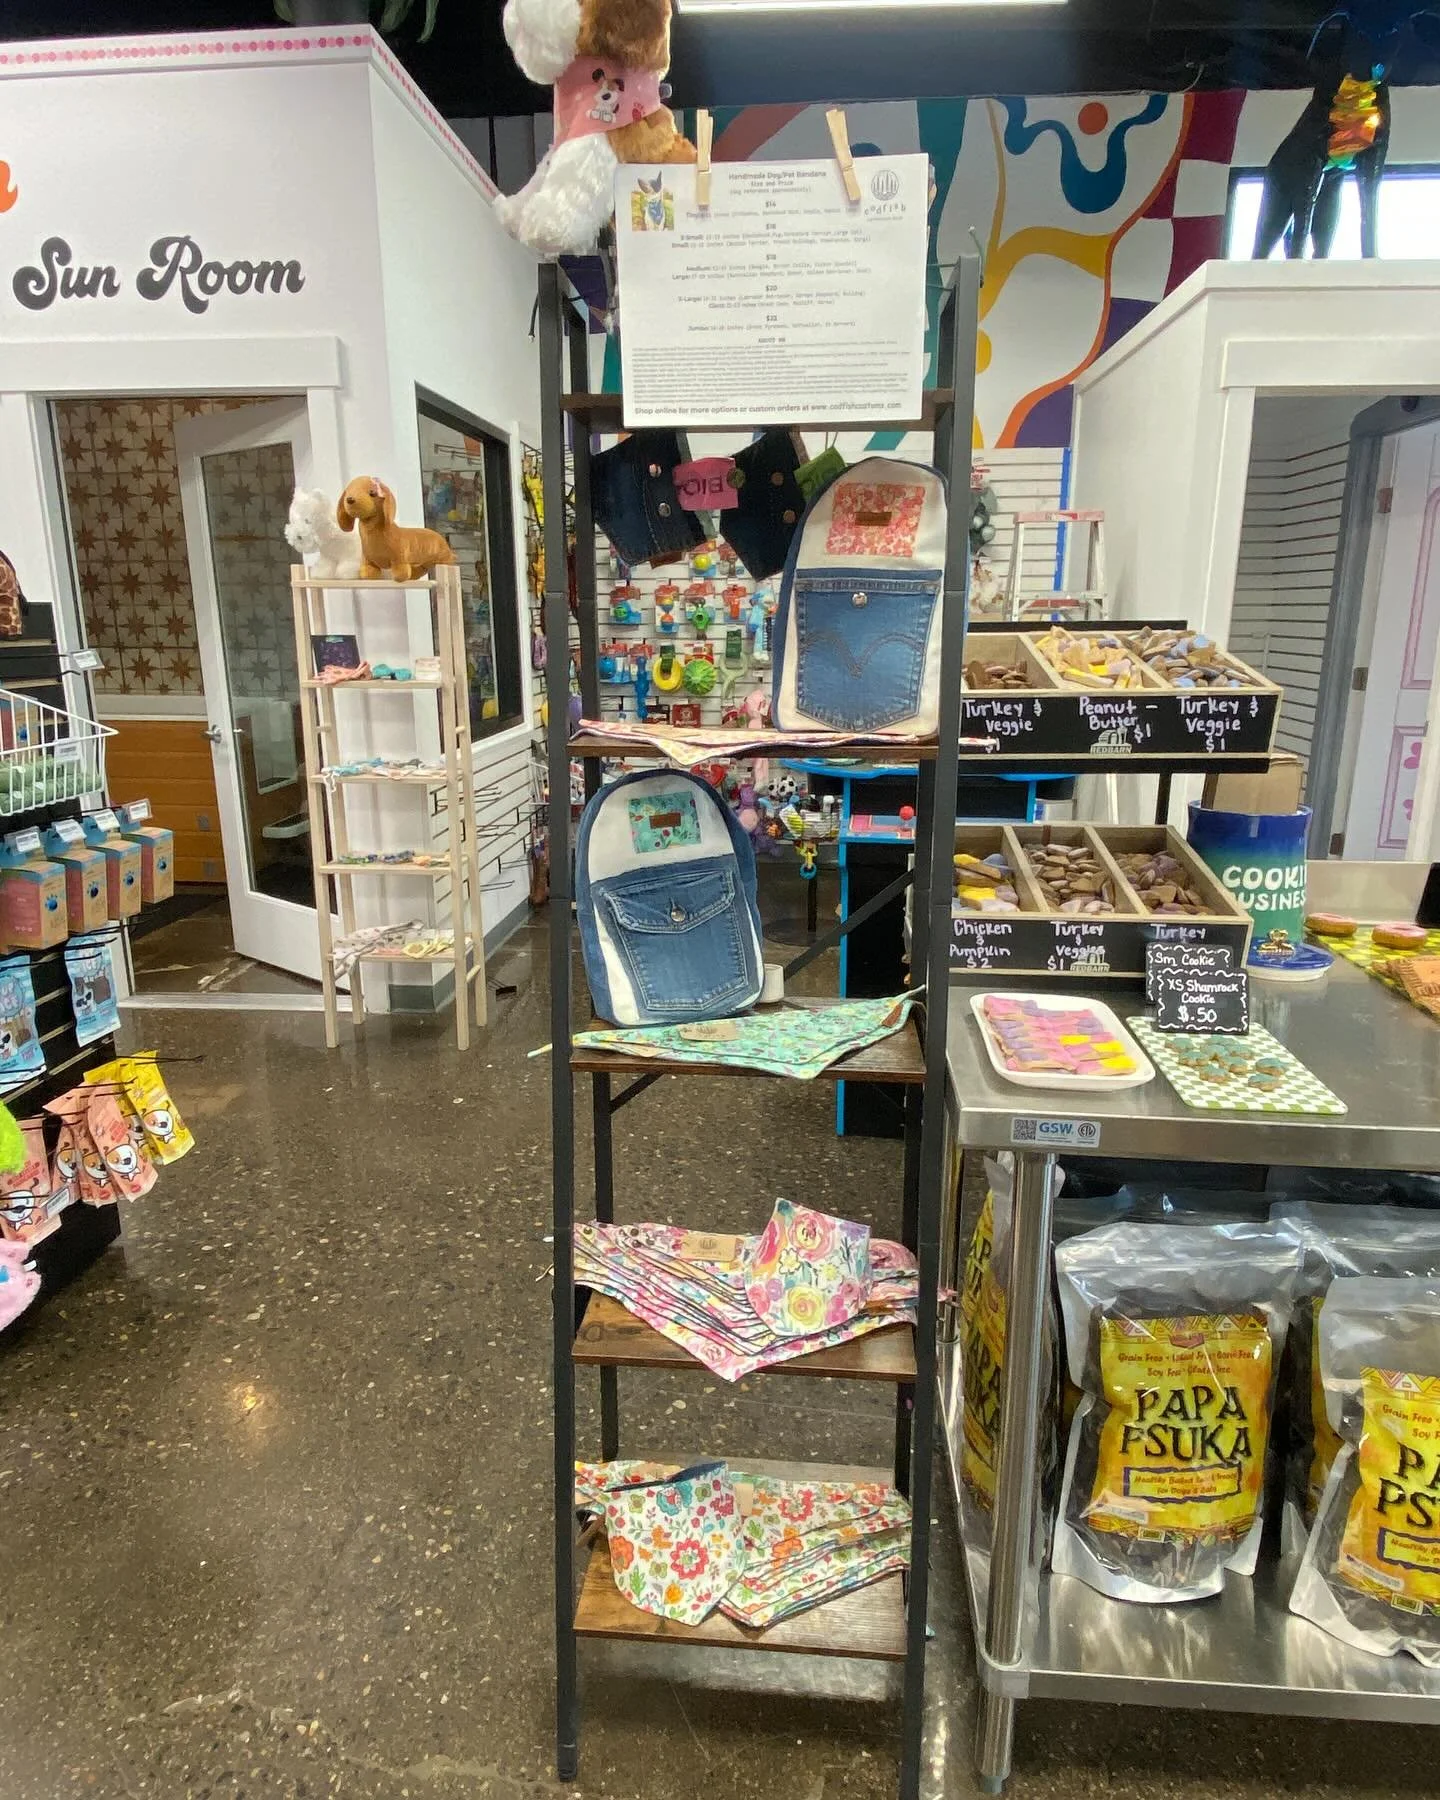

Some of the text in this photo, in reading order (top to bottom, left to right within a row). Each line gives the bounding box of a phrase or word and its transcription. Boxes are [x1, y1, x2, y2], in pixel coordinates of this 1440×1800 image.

[728, 172, 765, 180] Handmade
[12, 235, 306, 314] Sun Room
[635, 407, 654, 415] Shop
[711, 406, 739, 415] options
[748, 405, 776, 413] custom
[777, 405, 801, 413] orders
[960, 699, 1024, 719] Turkey
[1078, 695, 1137, 716] Peanut
[1175, 696, 1240, 716] Turkey
[1088, 715, 1138, 731] Butter
[1133, 722, 1152, 744] $1
[1205, 737, 1226, 754] $1
[1222, 865, 1307, 891] COOKI
[953, 921, 1013, 937] Chicken
[1050, 920, 1105, 937] Turkey
[1150, 923, 1207, 940] Turkey
[949, 945, 1012, 960] Pumpkin
[1154, 952, 1216, 967] Sm Cookie
[967, 957, 993, 969] $2
[1047, 954, 1065, 971] $1
[1167, 978, 1240, 993] XS Shamrock
[1181, 991, 1216, 1004] Cookie
[1177, 1004, 1218, 1024] $.50
[1039, 1121, 1073, 1135] GSW
[1118, 1352, 1143, 1363] Grain
[1145, 1352, 1164, 1363] Free
[1147, 1367, 1164, 1377] Soy
[1134, 1384, 1248, 1423] PAPA
[1383, 1403, 1433, 1424] Grain Free
[1412, 1427, 1431, 1441] Soy
